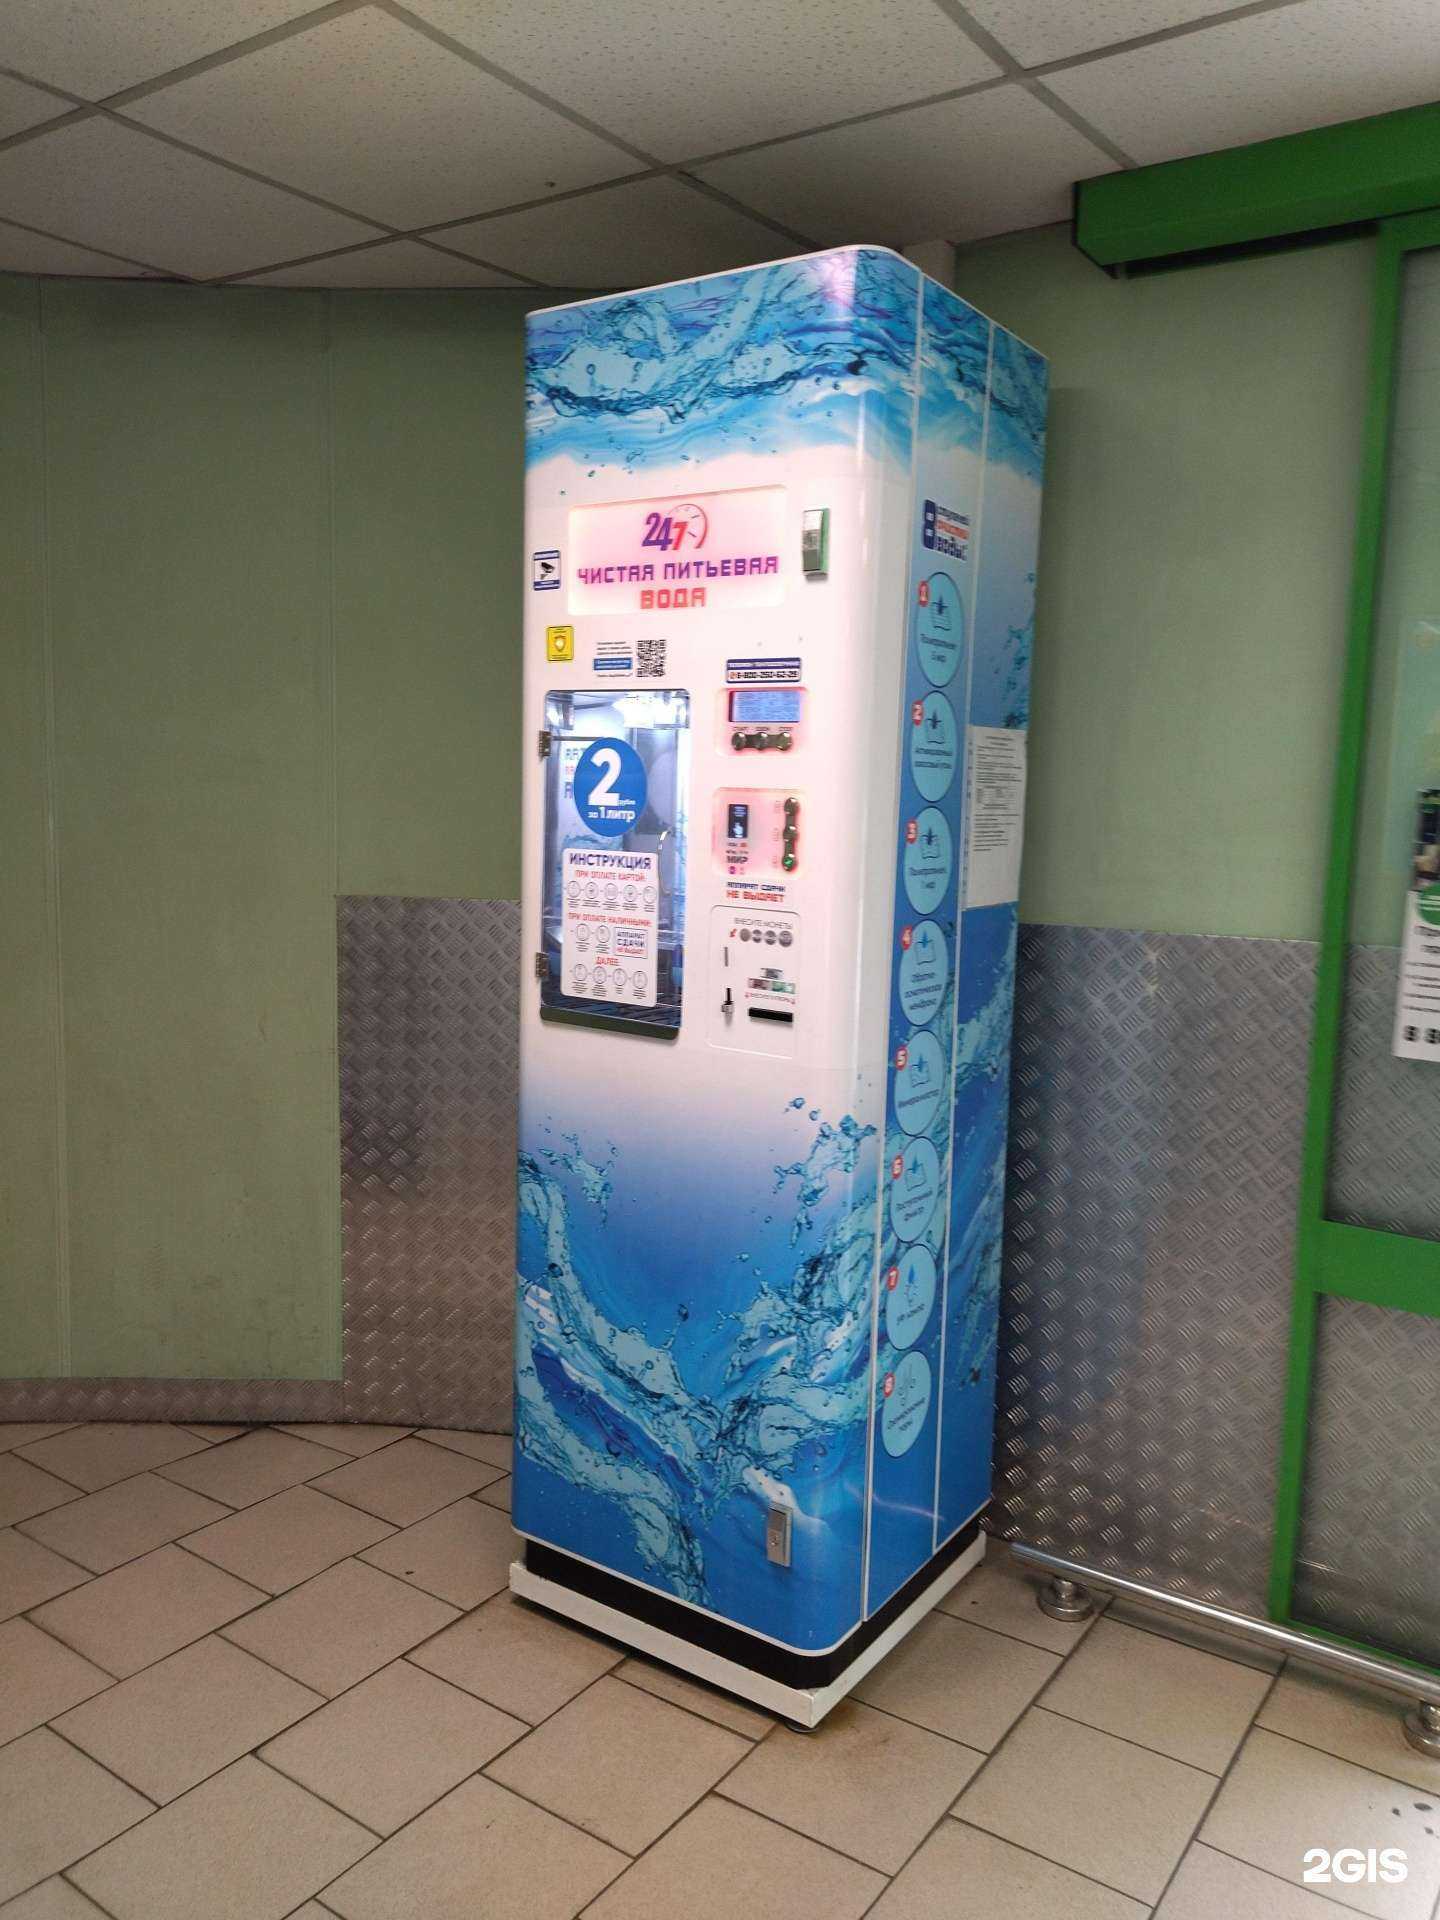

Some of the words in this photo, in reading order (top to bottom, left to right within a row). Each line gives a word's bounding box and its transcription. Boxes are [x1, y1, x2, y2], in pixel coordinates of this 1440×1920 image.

[577, 564, 654, 584] ЧИСТАЯ
[664, 556, 779, 580] ПИТЬЕВАЯ
[640, 587, 706, 609] ВОДА
[588, 747, 622, 806] 2
[599, 806, 606, 819] 1
[605, 809, 636, 822] литр
[569, 852, 652, 870] ИНСТРУКЦИЯ
[575, 869, 589, 878] ПРИ
[591, 871, 617, 880] ОПЛАТЕ
[727, 890, 739, 899] НЕ
